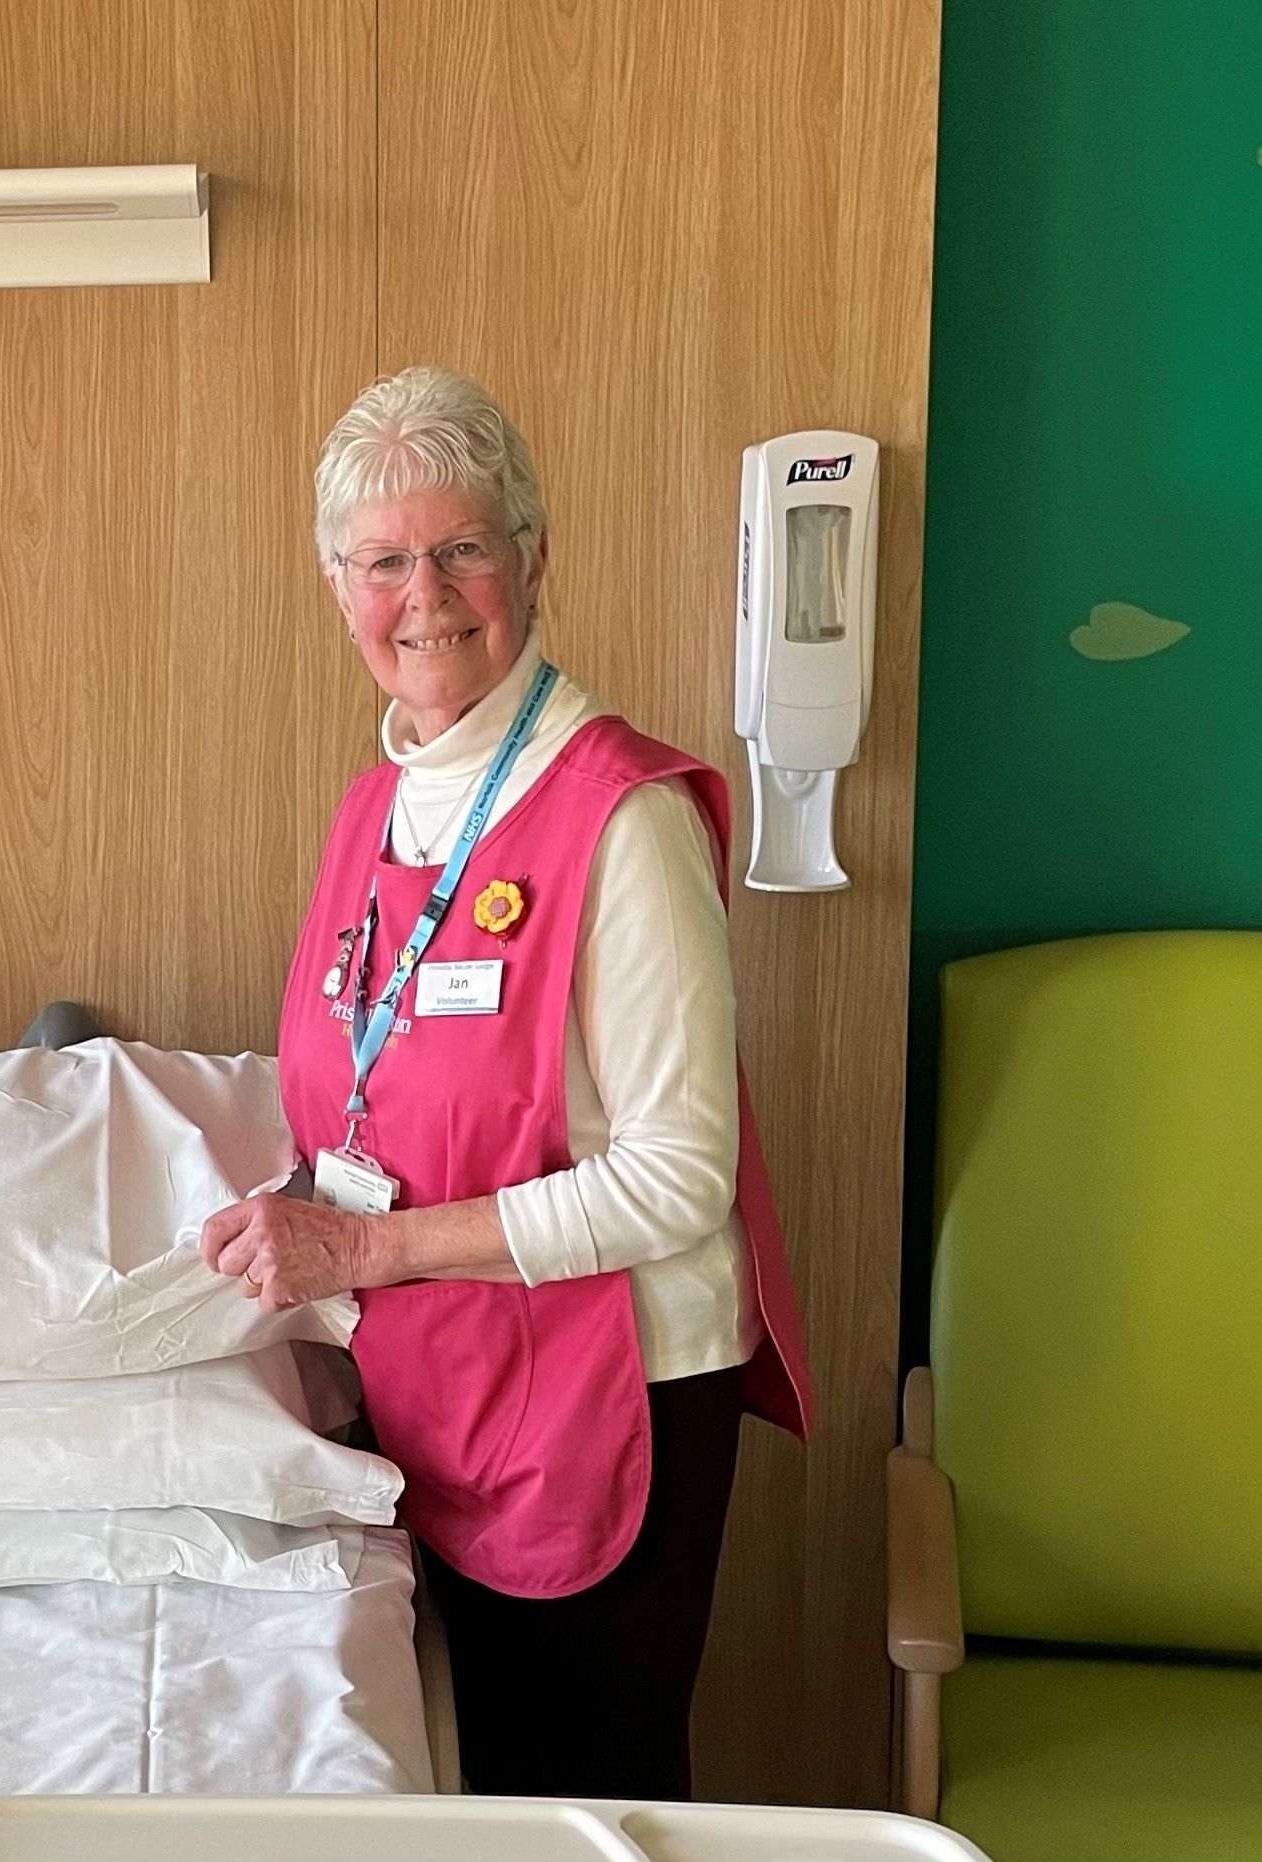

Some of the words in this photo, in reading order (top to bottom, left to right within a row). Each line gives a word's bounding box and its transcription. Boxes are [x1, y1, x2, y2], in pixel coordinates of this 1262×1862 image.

[794, 461, 847, 480] Purell
[463, 812, 483, 842] NHS
[449, 977, 469, 989] Jan
[436, 997, 478, 1005] Volunteer
